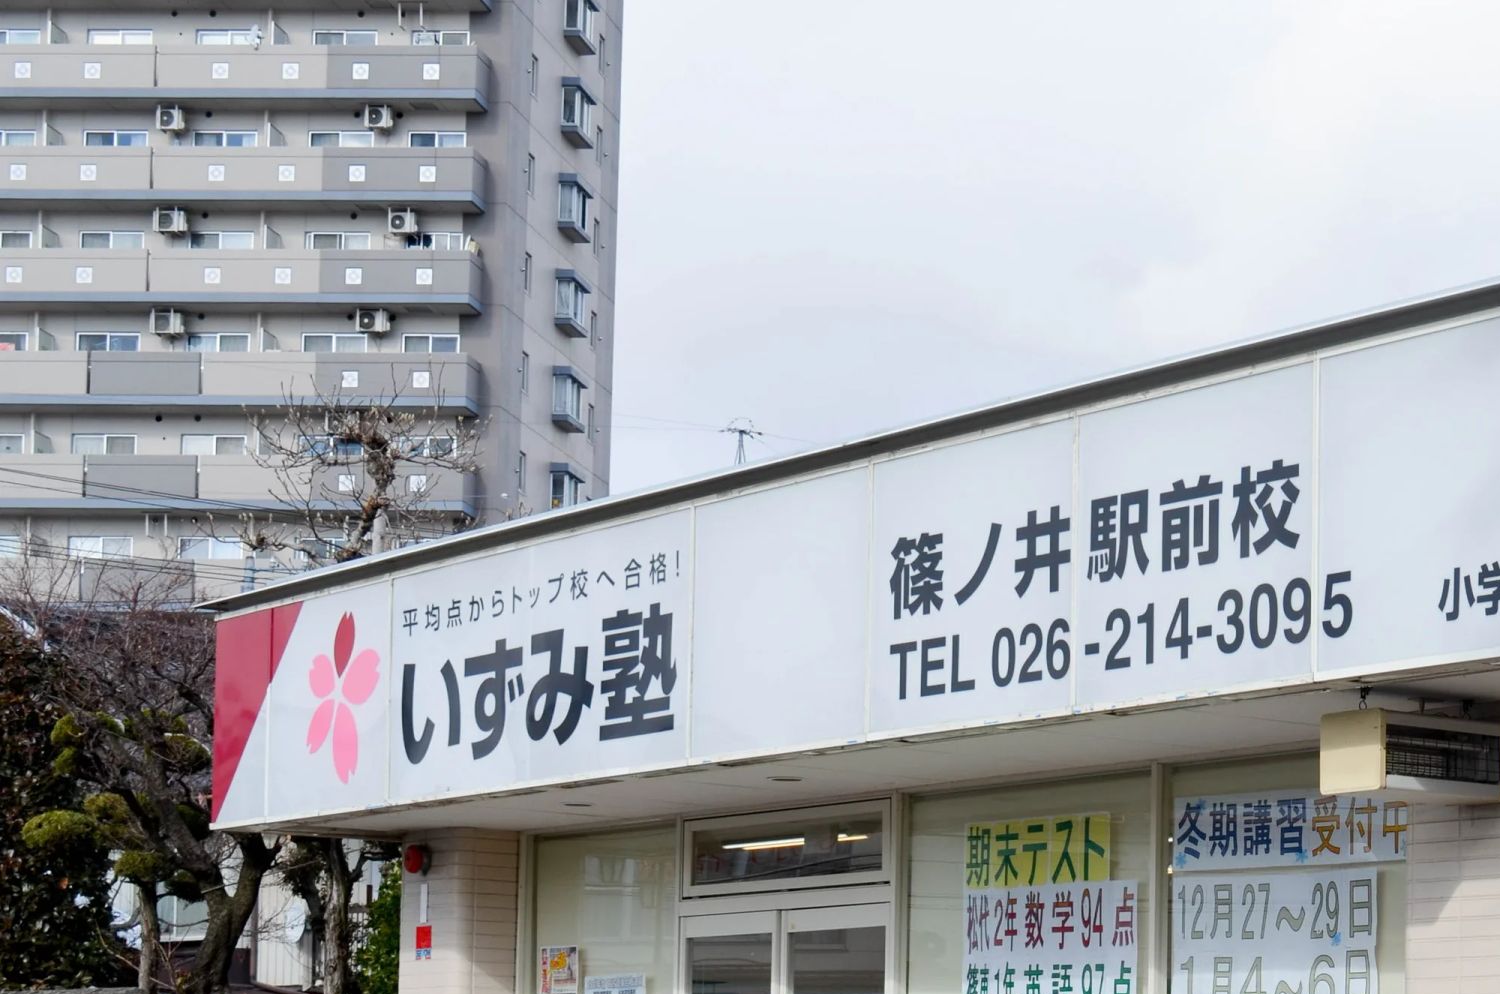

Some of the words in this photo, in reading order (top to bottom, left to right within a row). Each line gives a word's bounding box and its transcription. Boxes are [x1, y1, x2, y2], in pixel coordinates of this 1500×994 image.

[889, 459, 1301, 620] 篠ノ井駅前校
[401, 602, 677, 765] いずみ塾
[890, 634, 976, 700] TEL
[991, 570, 1353, 688] 026-214-3095
[965, 816, 1106, 887] 期末テスト
